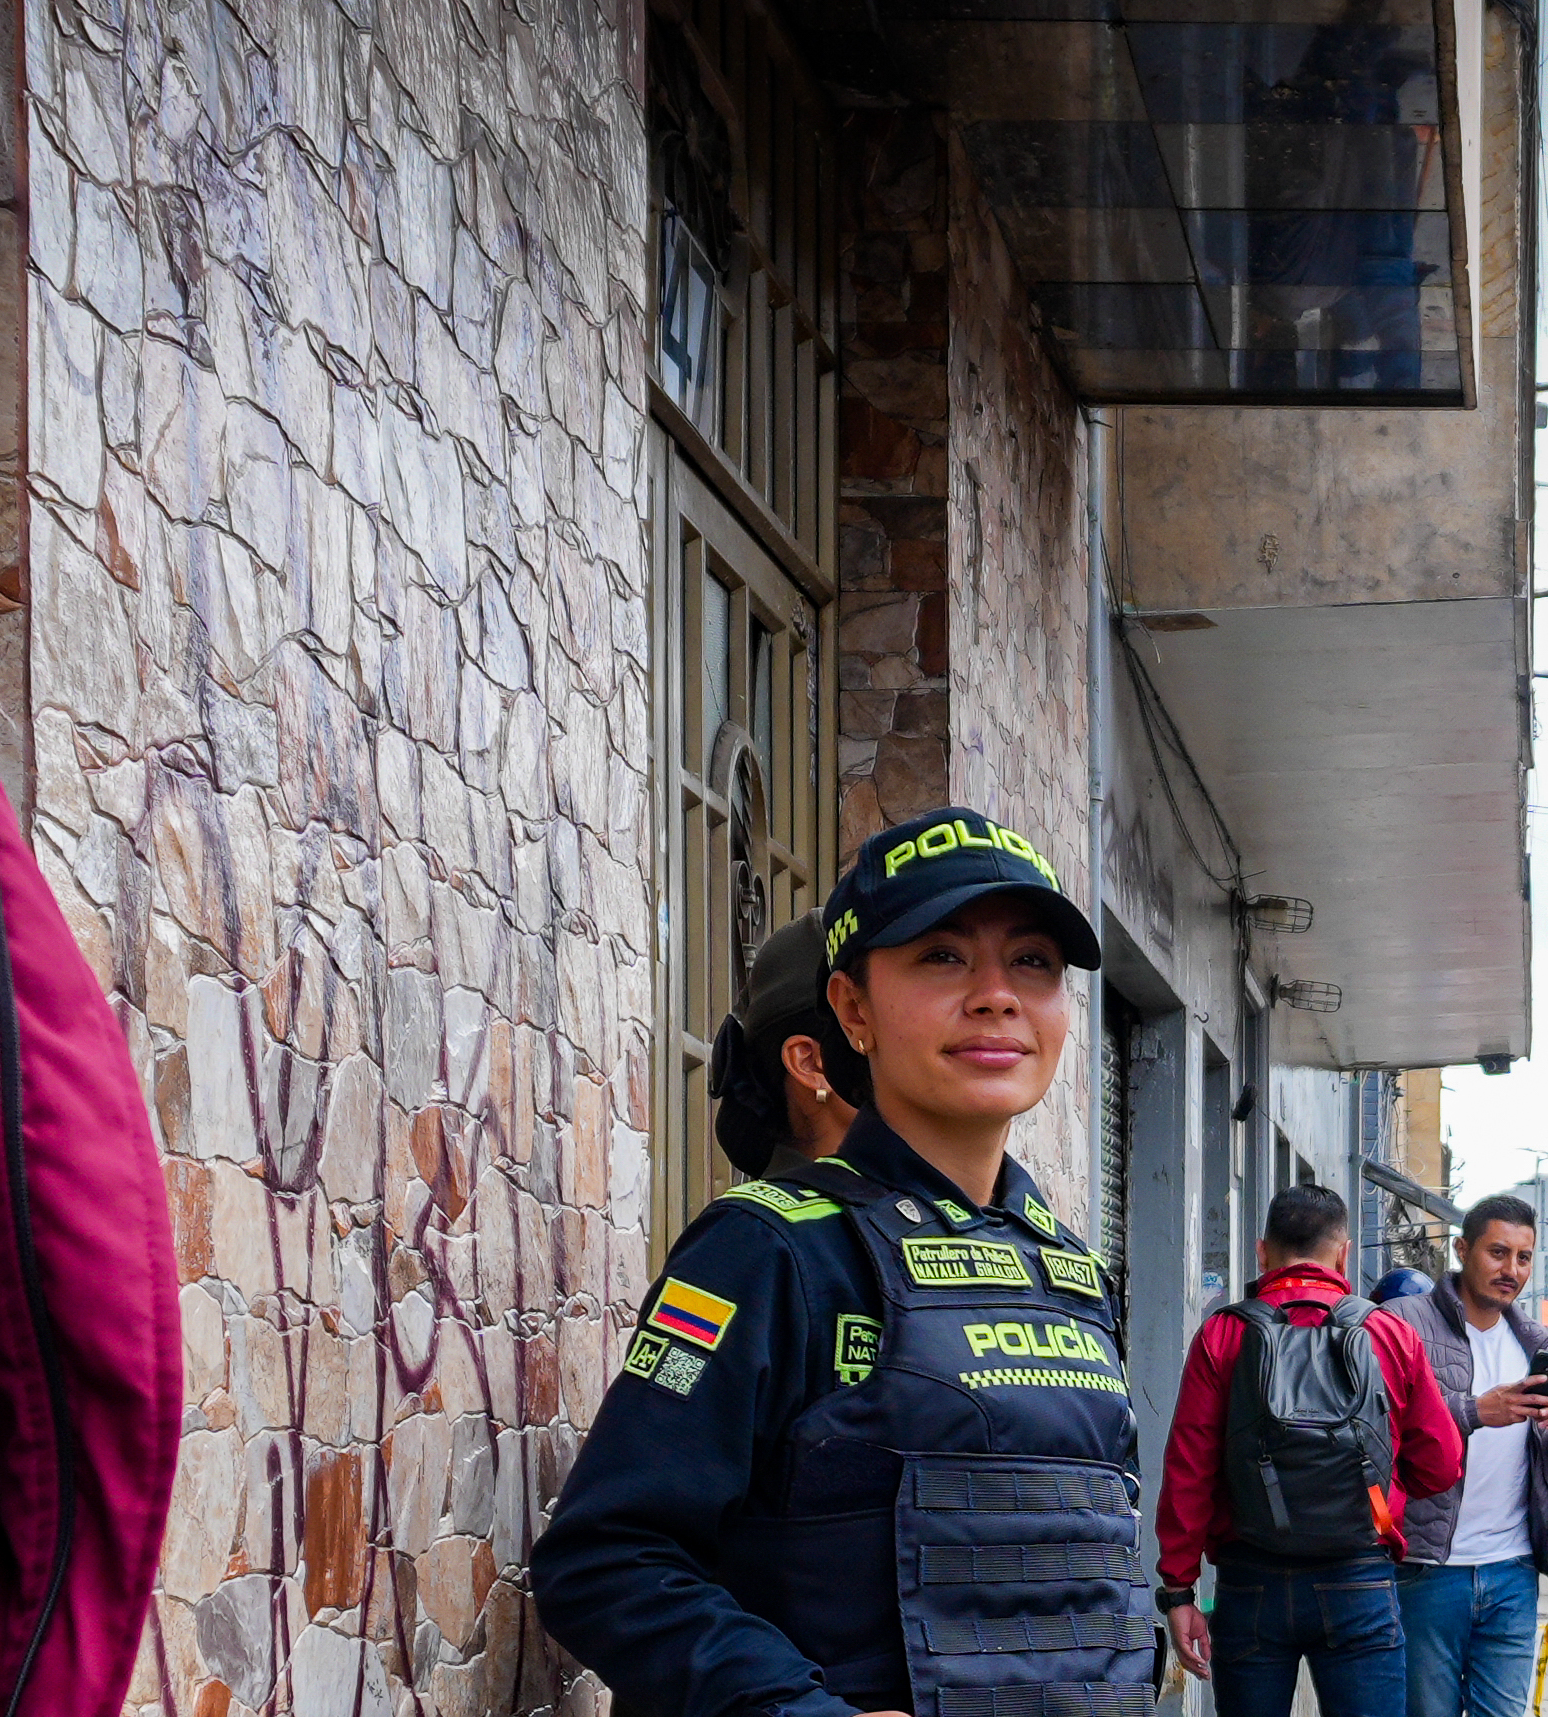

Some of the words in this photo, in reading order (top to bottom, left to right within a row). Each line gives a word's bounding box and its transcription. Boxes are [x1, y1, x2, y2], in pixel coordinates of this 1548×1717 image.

[913, 1262, 969, 1279] NATALIA
[975, 1262, 1022, 1279] GIRALDO
[1047, 1256, 1092, 1286] 181457
[963, 1318, 1110, 1366] POLICÍA
